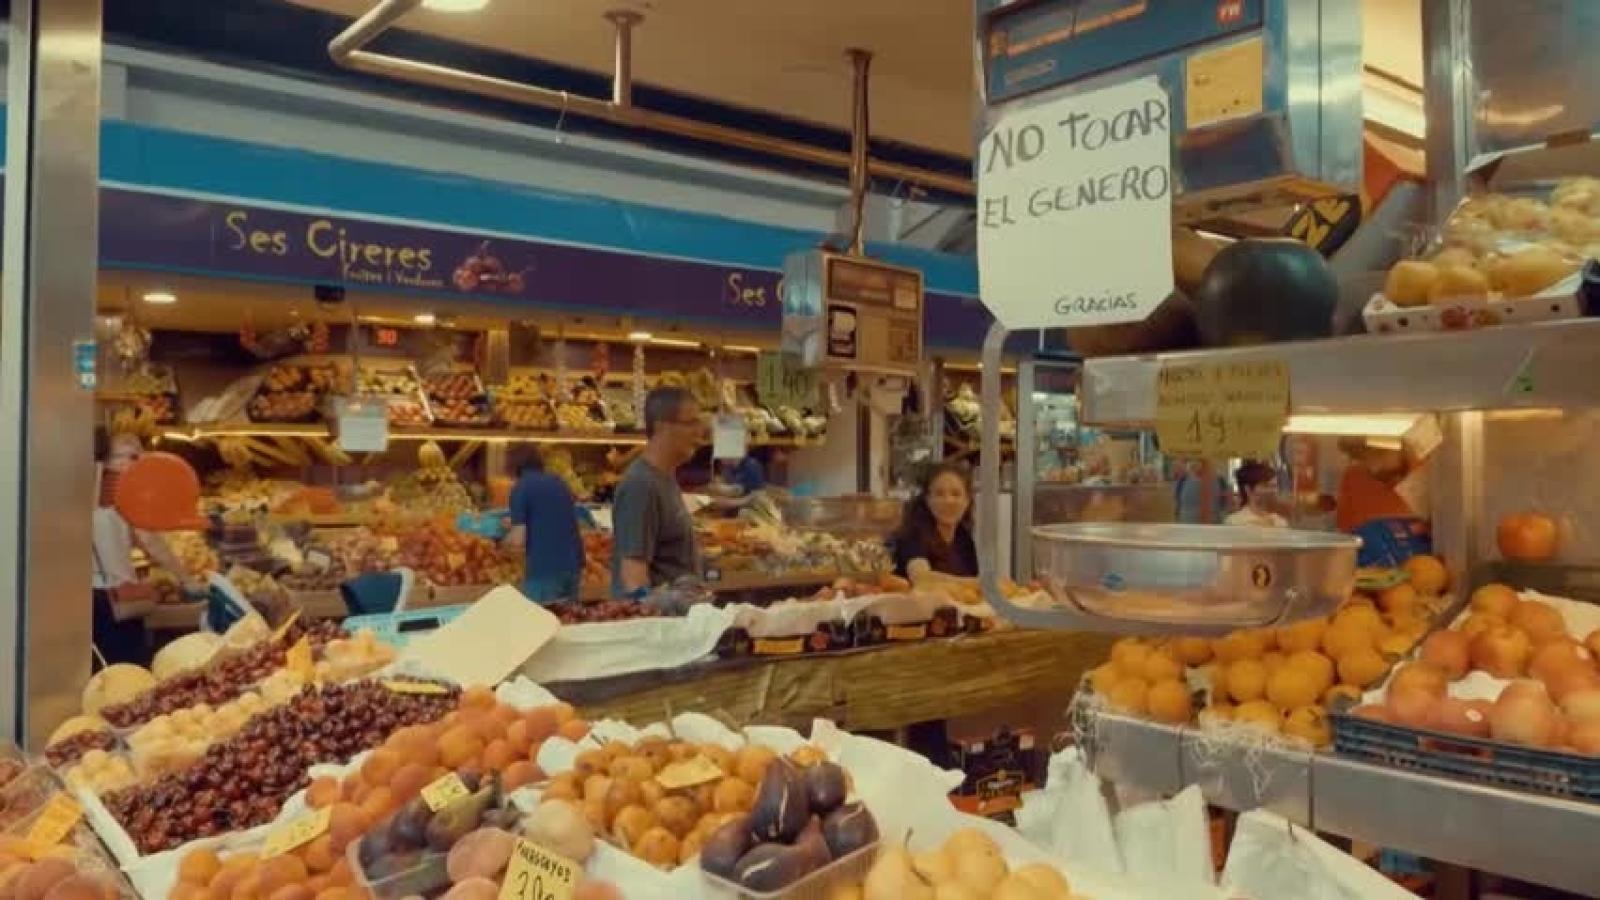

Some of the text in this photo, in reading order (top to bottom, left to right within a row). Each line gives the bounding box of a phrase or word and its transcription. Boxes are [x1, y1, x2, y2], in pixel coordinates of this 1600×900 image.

[986, 99, 1167, 173] NO TOCAR
[983, 165, 1169, 228] EL GENERO
[225, 209, 433, 271] Ses Cireres
[727, 272, 767, 307] Ses
[1054, 289, 1137, 315] GRACIAS
